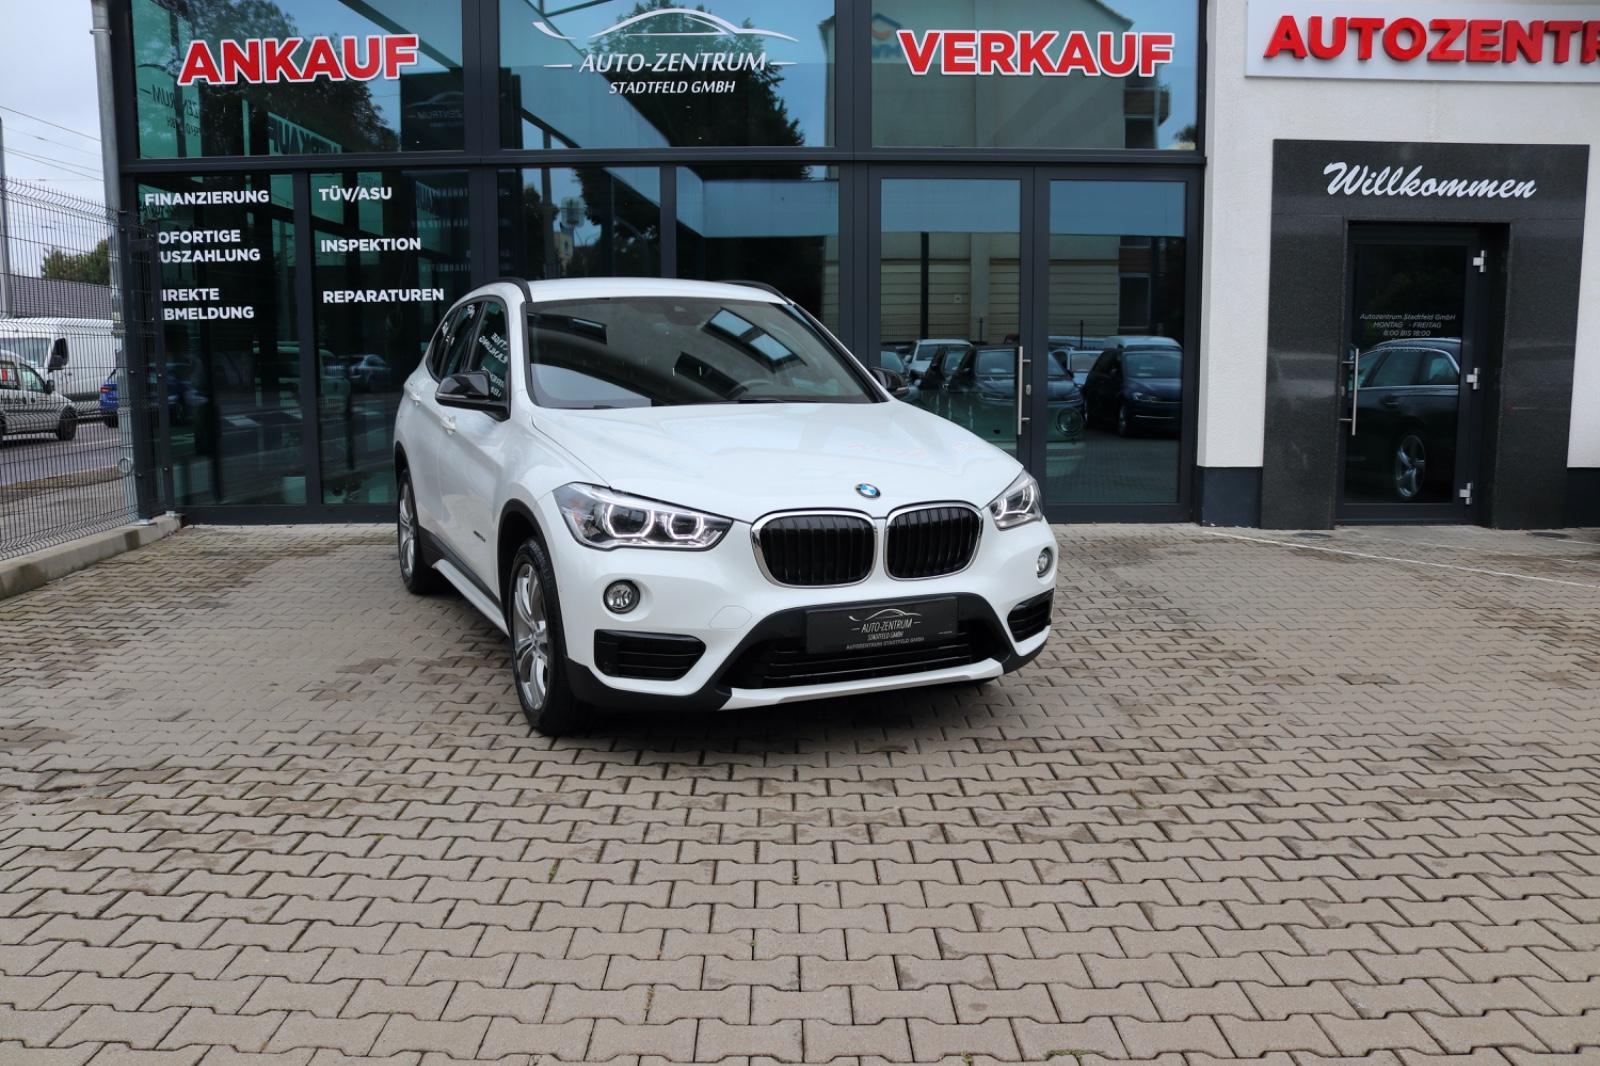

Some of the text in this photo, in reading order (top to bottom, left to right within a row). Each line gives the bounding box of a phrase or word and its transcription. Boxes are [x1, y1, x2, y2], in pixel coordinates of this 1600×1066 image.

[179, 35, 418, 84] ANKAUF
[898, 31, 1174, 76] VERKAUF
[579, 51, 767, 74] AUTO-ZENTRUM
[608, 80, 736, 95] STADTFELD GMBH
[1323, 161, 1537, 199] Willkommen
[144, 189, 269, 206] FINANZIERUNG
[318, 185, 392, 202] TÜV/ASU
[320, 237, 421, 252] INSPEKTION
[322, 288, 445, 304] REPARATUREN
[1360, 313, 1456, 321] Autozentrum Stadtfeld GmbH
[1373, 321, 1404, 329] MONTAG
[1412, 321, 1442, 329] FREITAG
[861, 618, 913, 633] AUTO-ZENTRUM
